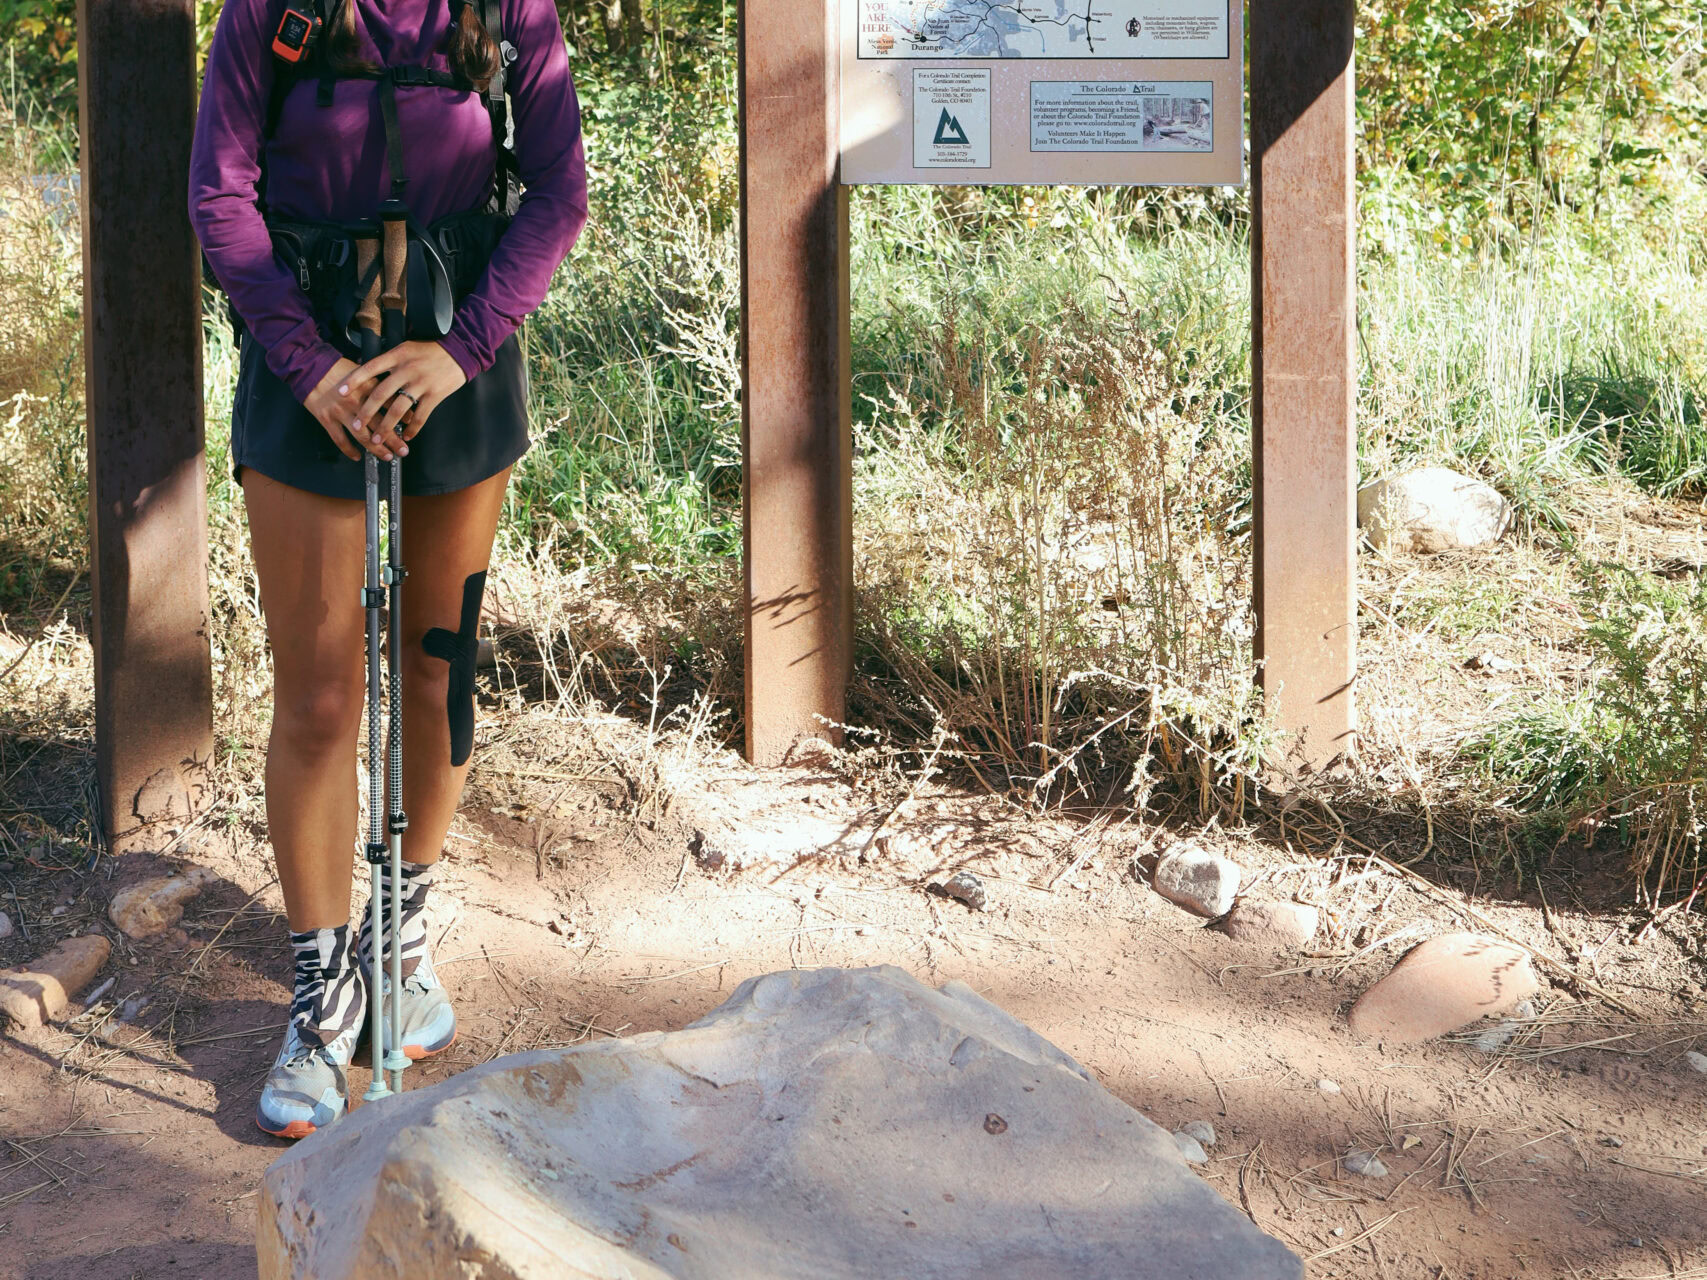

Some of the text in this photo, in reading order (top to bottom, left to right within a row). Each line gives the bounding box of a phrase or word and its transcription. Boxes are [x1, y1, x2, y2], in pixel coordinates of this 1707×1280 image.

[865, 2, 889, 11] YOU
[867, 13, 887, 22] ARE
[862, 23, 891, 33] HERE
[911, 43, 944, 51] Durango
[1080, 85, 1155, 93] The Colorado Trail
[1088, 106, 1115, 114] becoming
[1103, 130, 1126, 138] Happen
